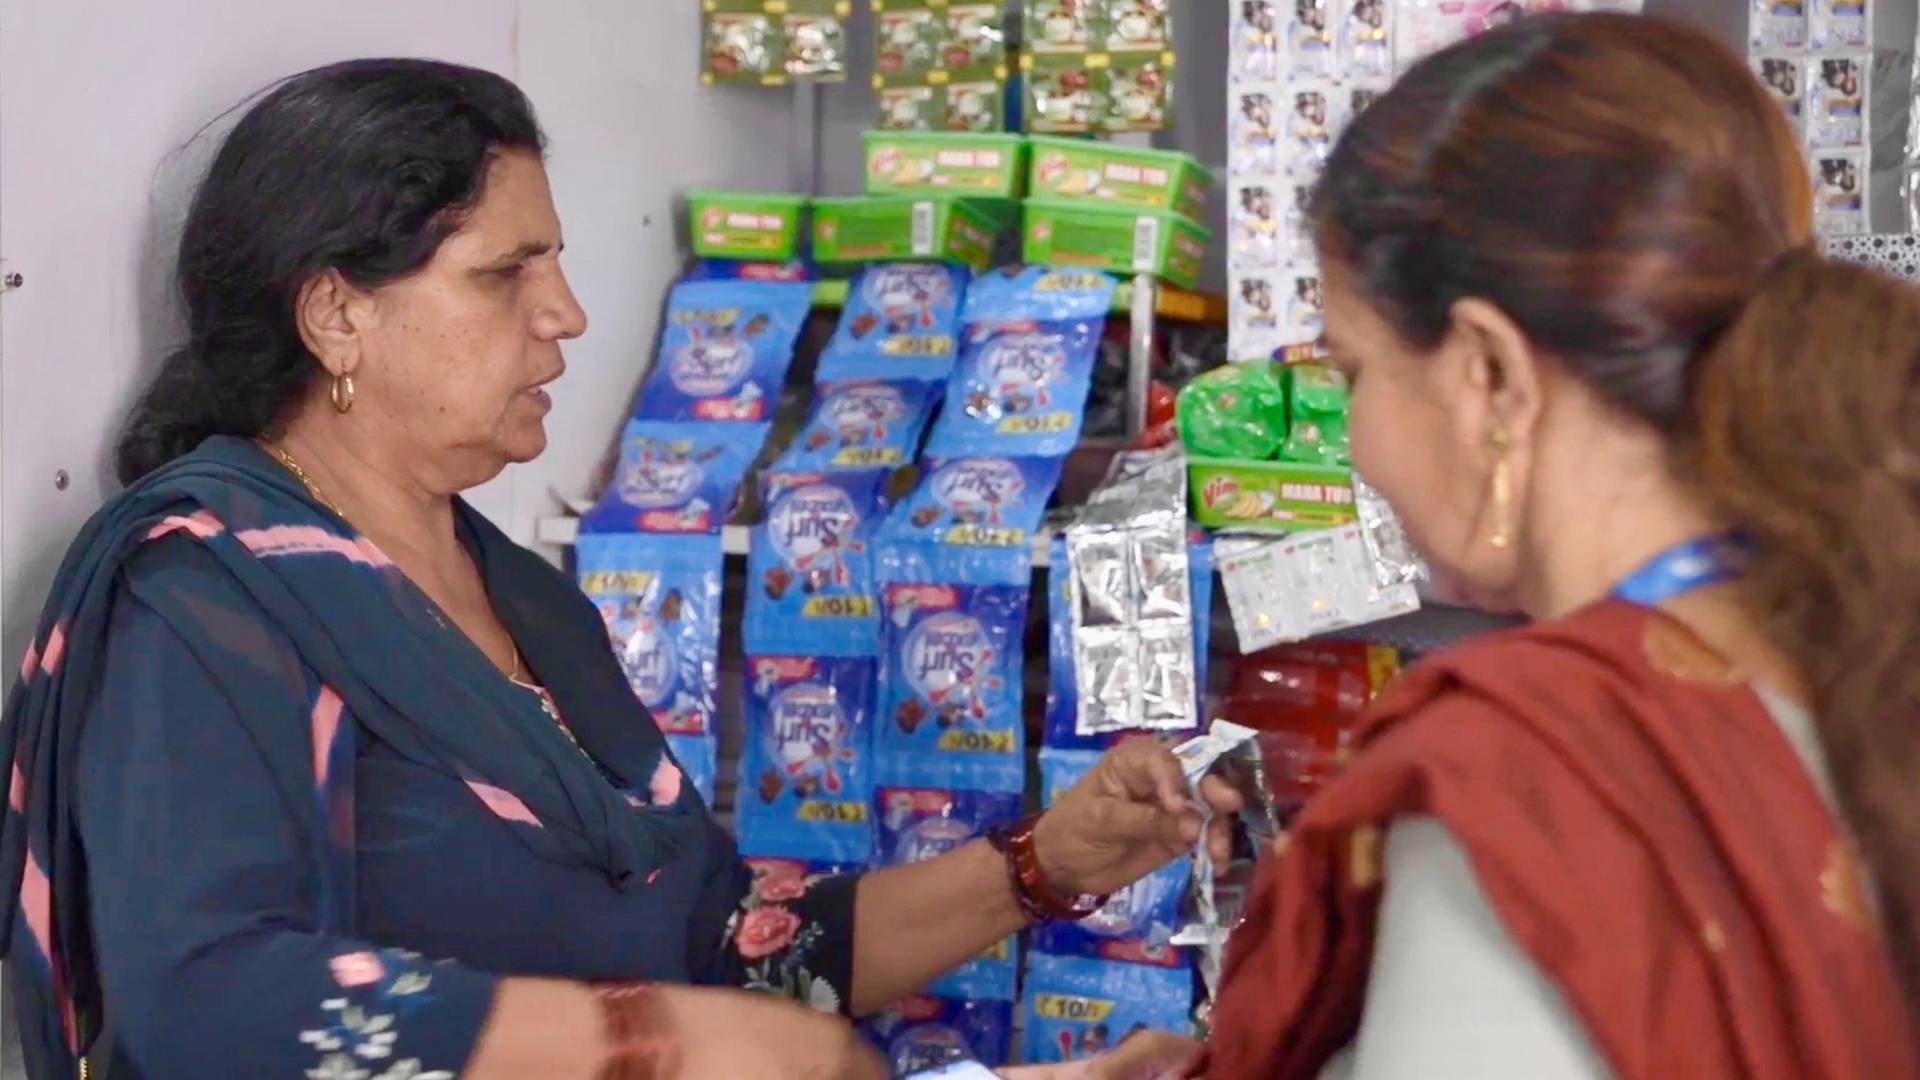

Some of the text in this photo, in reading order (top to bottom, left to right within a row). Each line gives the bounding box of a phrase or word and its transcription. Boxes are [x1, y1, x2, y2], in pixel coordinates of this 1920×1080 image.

[1203, 476, 1239, 508] Vim
[784, 517, 840, 549] Surf
[918, 650, 976, 683] Surf
[777, 723, 832, 757] Surf
